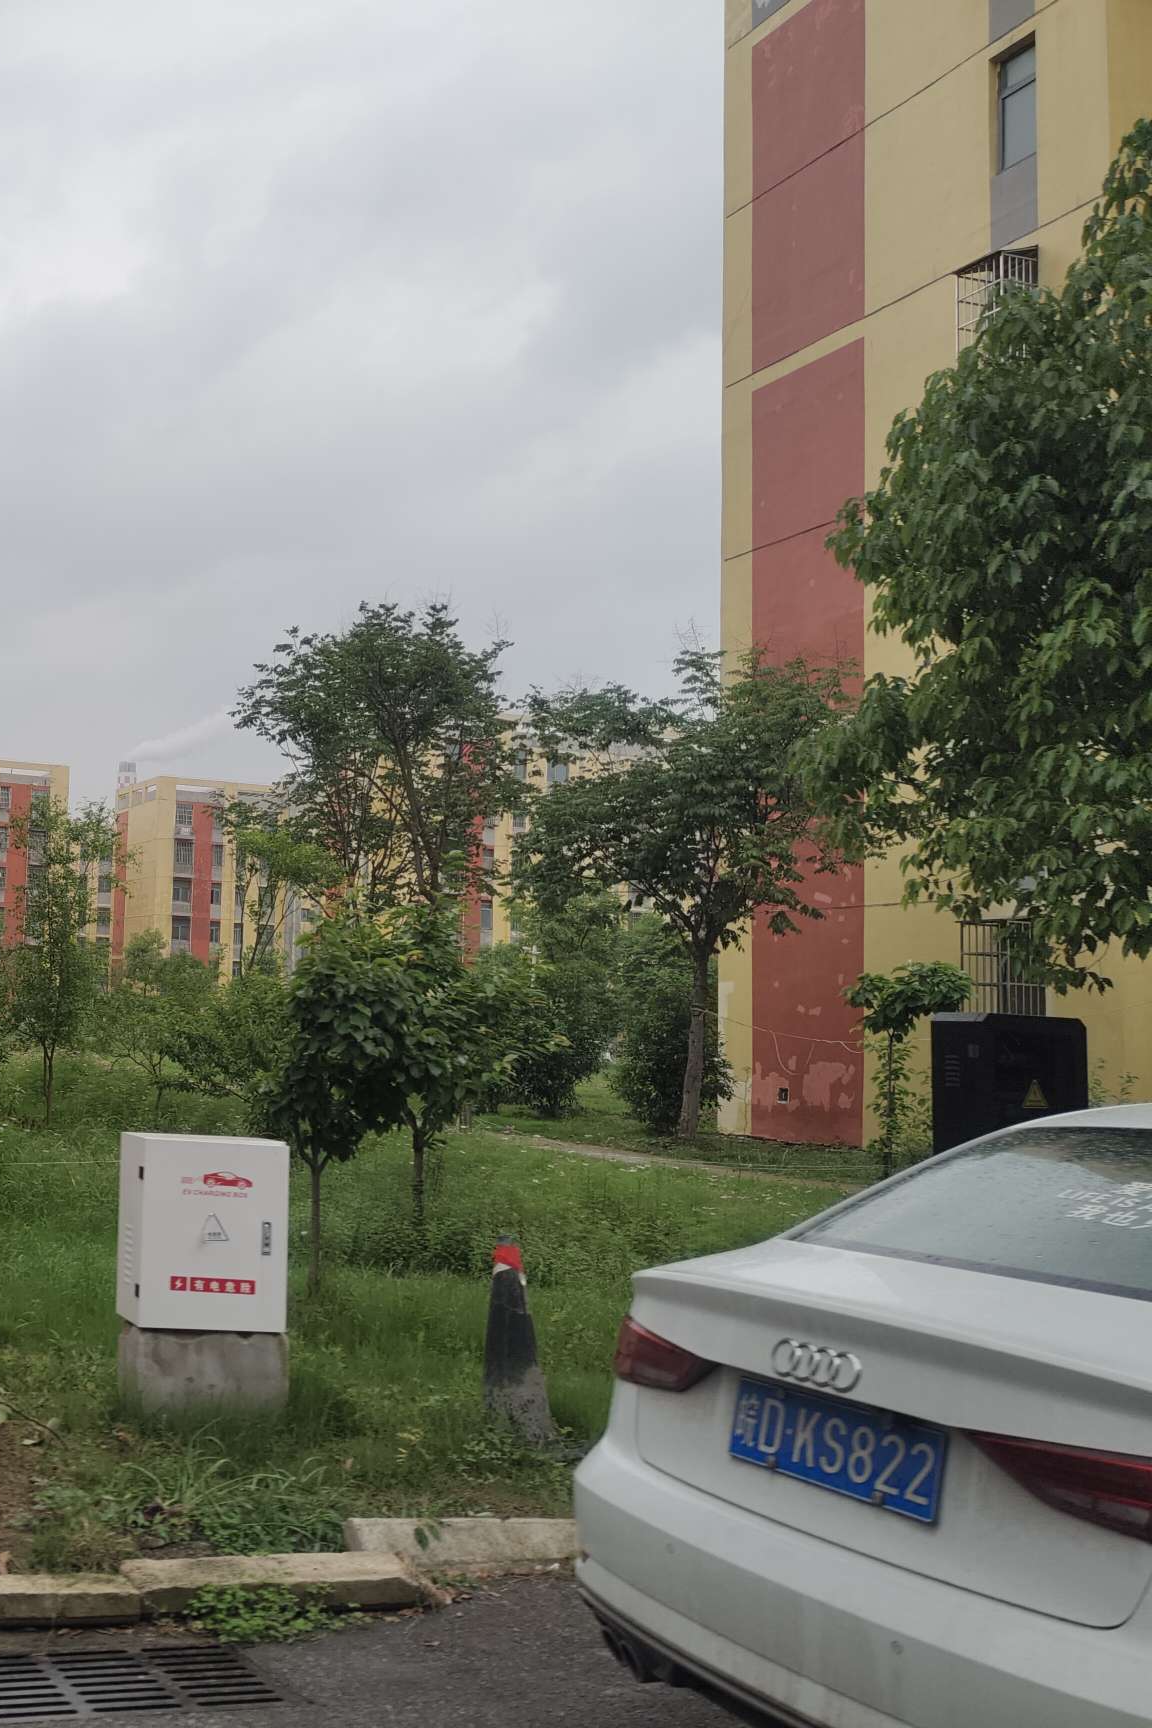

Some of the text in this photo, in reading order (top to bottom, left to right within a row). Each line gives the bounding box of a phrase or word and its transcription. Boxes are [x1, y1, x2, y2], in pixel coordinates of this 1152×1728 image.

[1056, 1189, 1113, 1204] LIFE
[193, 1279, 252, 1293] 有电危险
